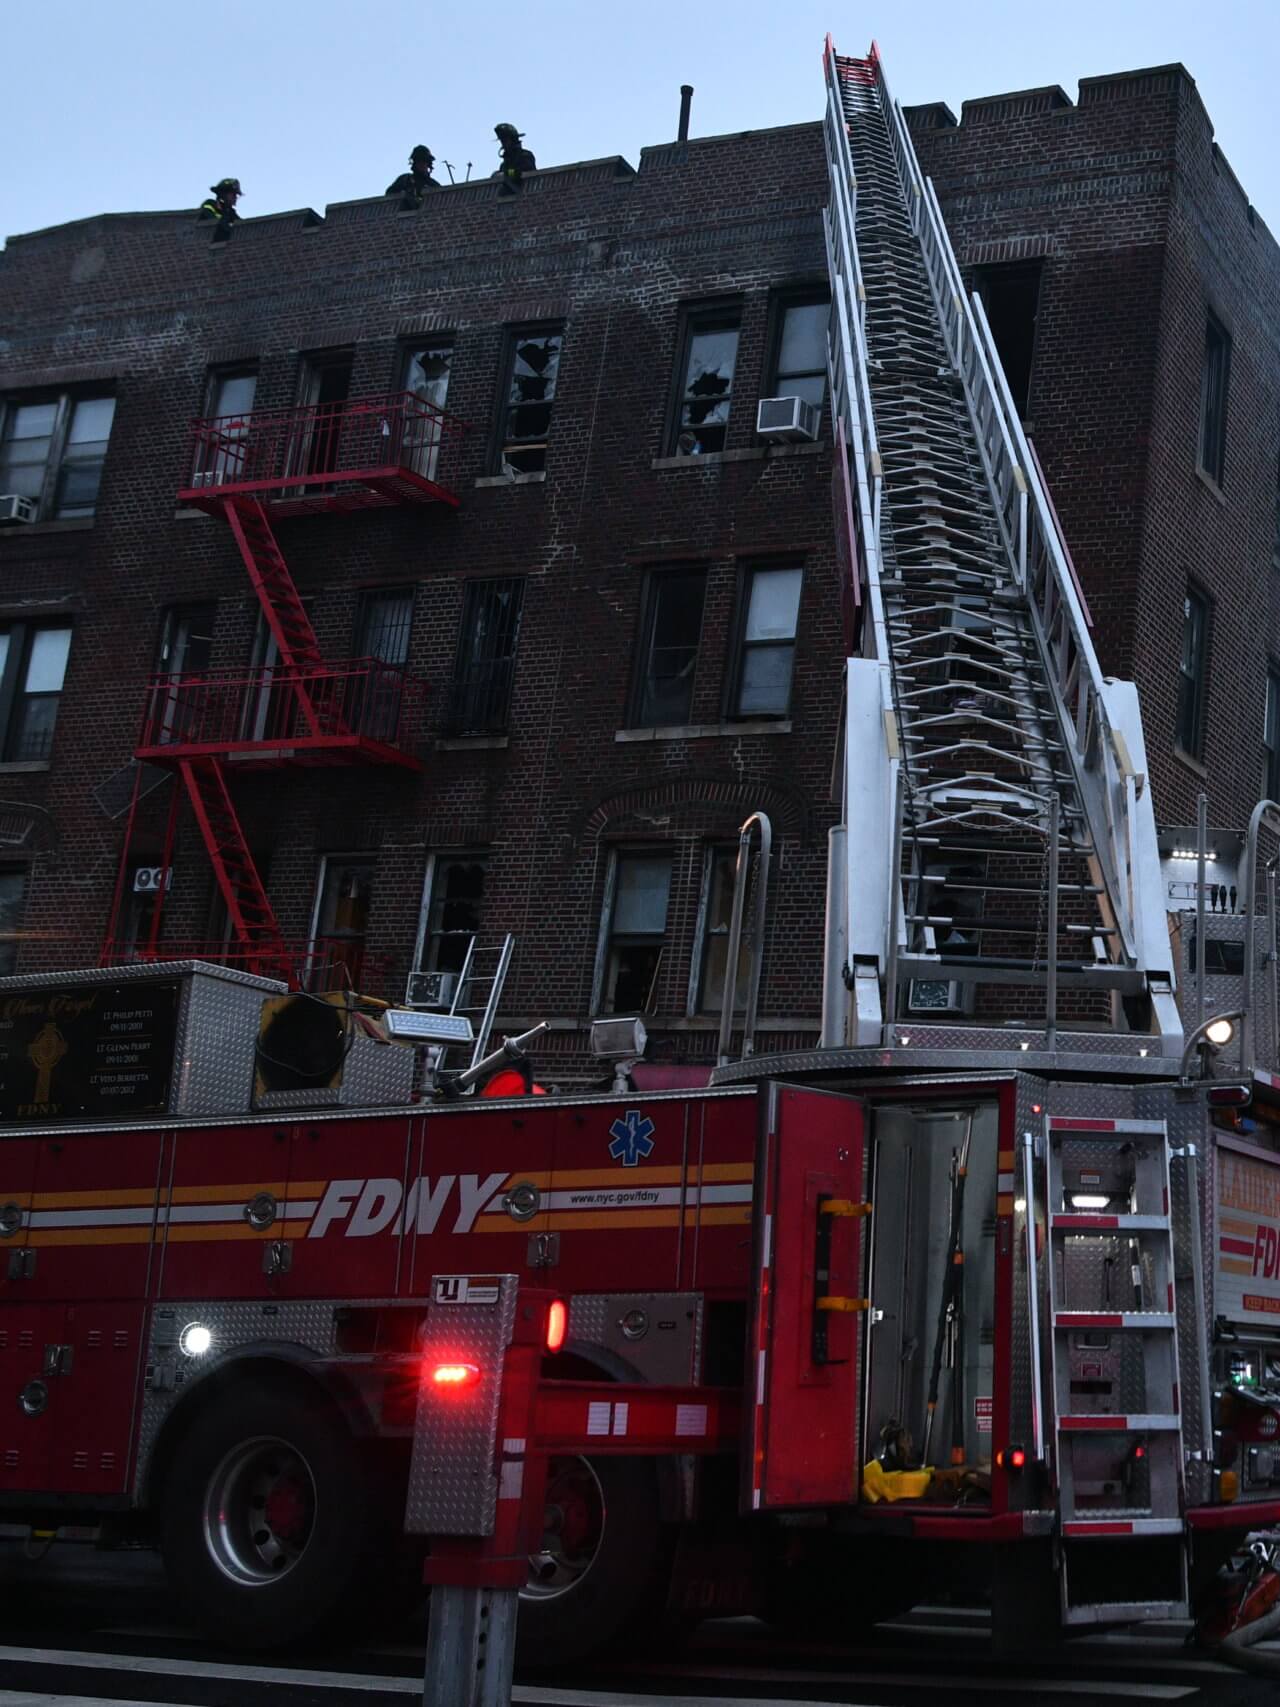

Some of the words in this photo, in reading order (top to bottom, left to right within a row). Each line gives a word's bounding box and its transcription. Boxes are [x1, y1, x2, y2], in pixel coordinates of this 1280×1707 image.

[17, 1103, 62, 1115] FDNY
[306, 1171, 511, 1239] FDNY
[570, 1189, 660, 1205] www.nyc.gov/fdny
